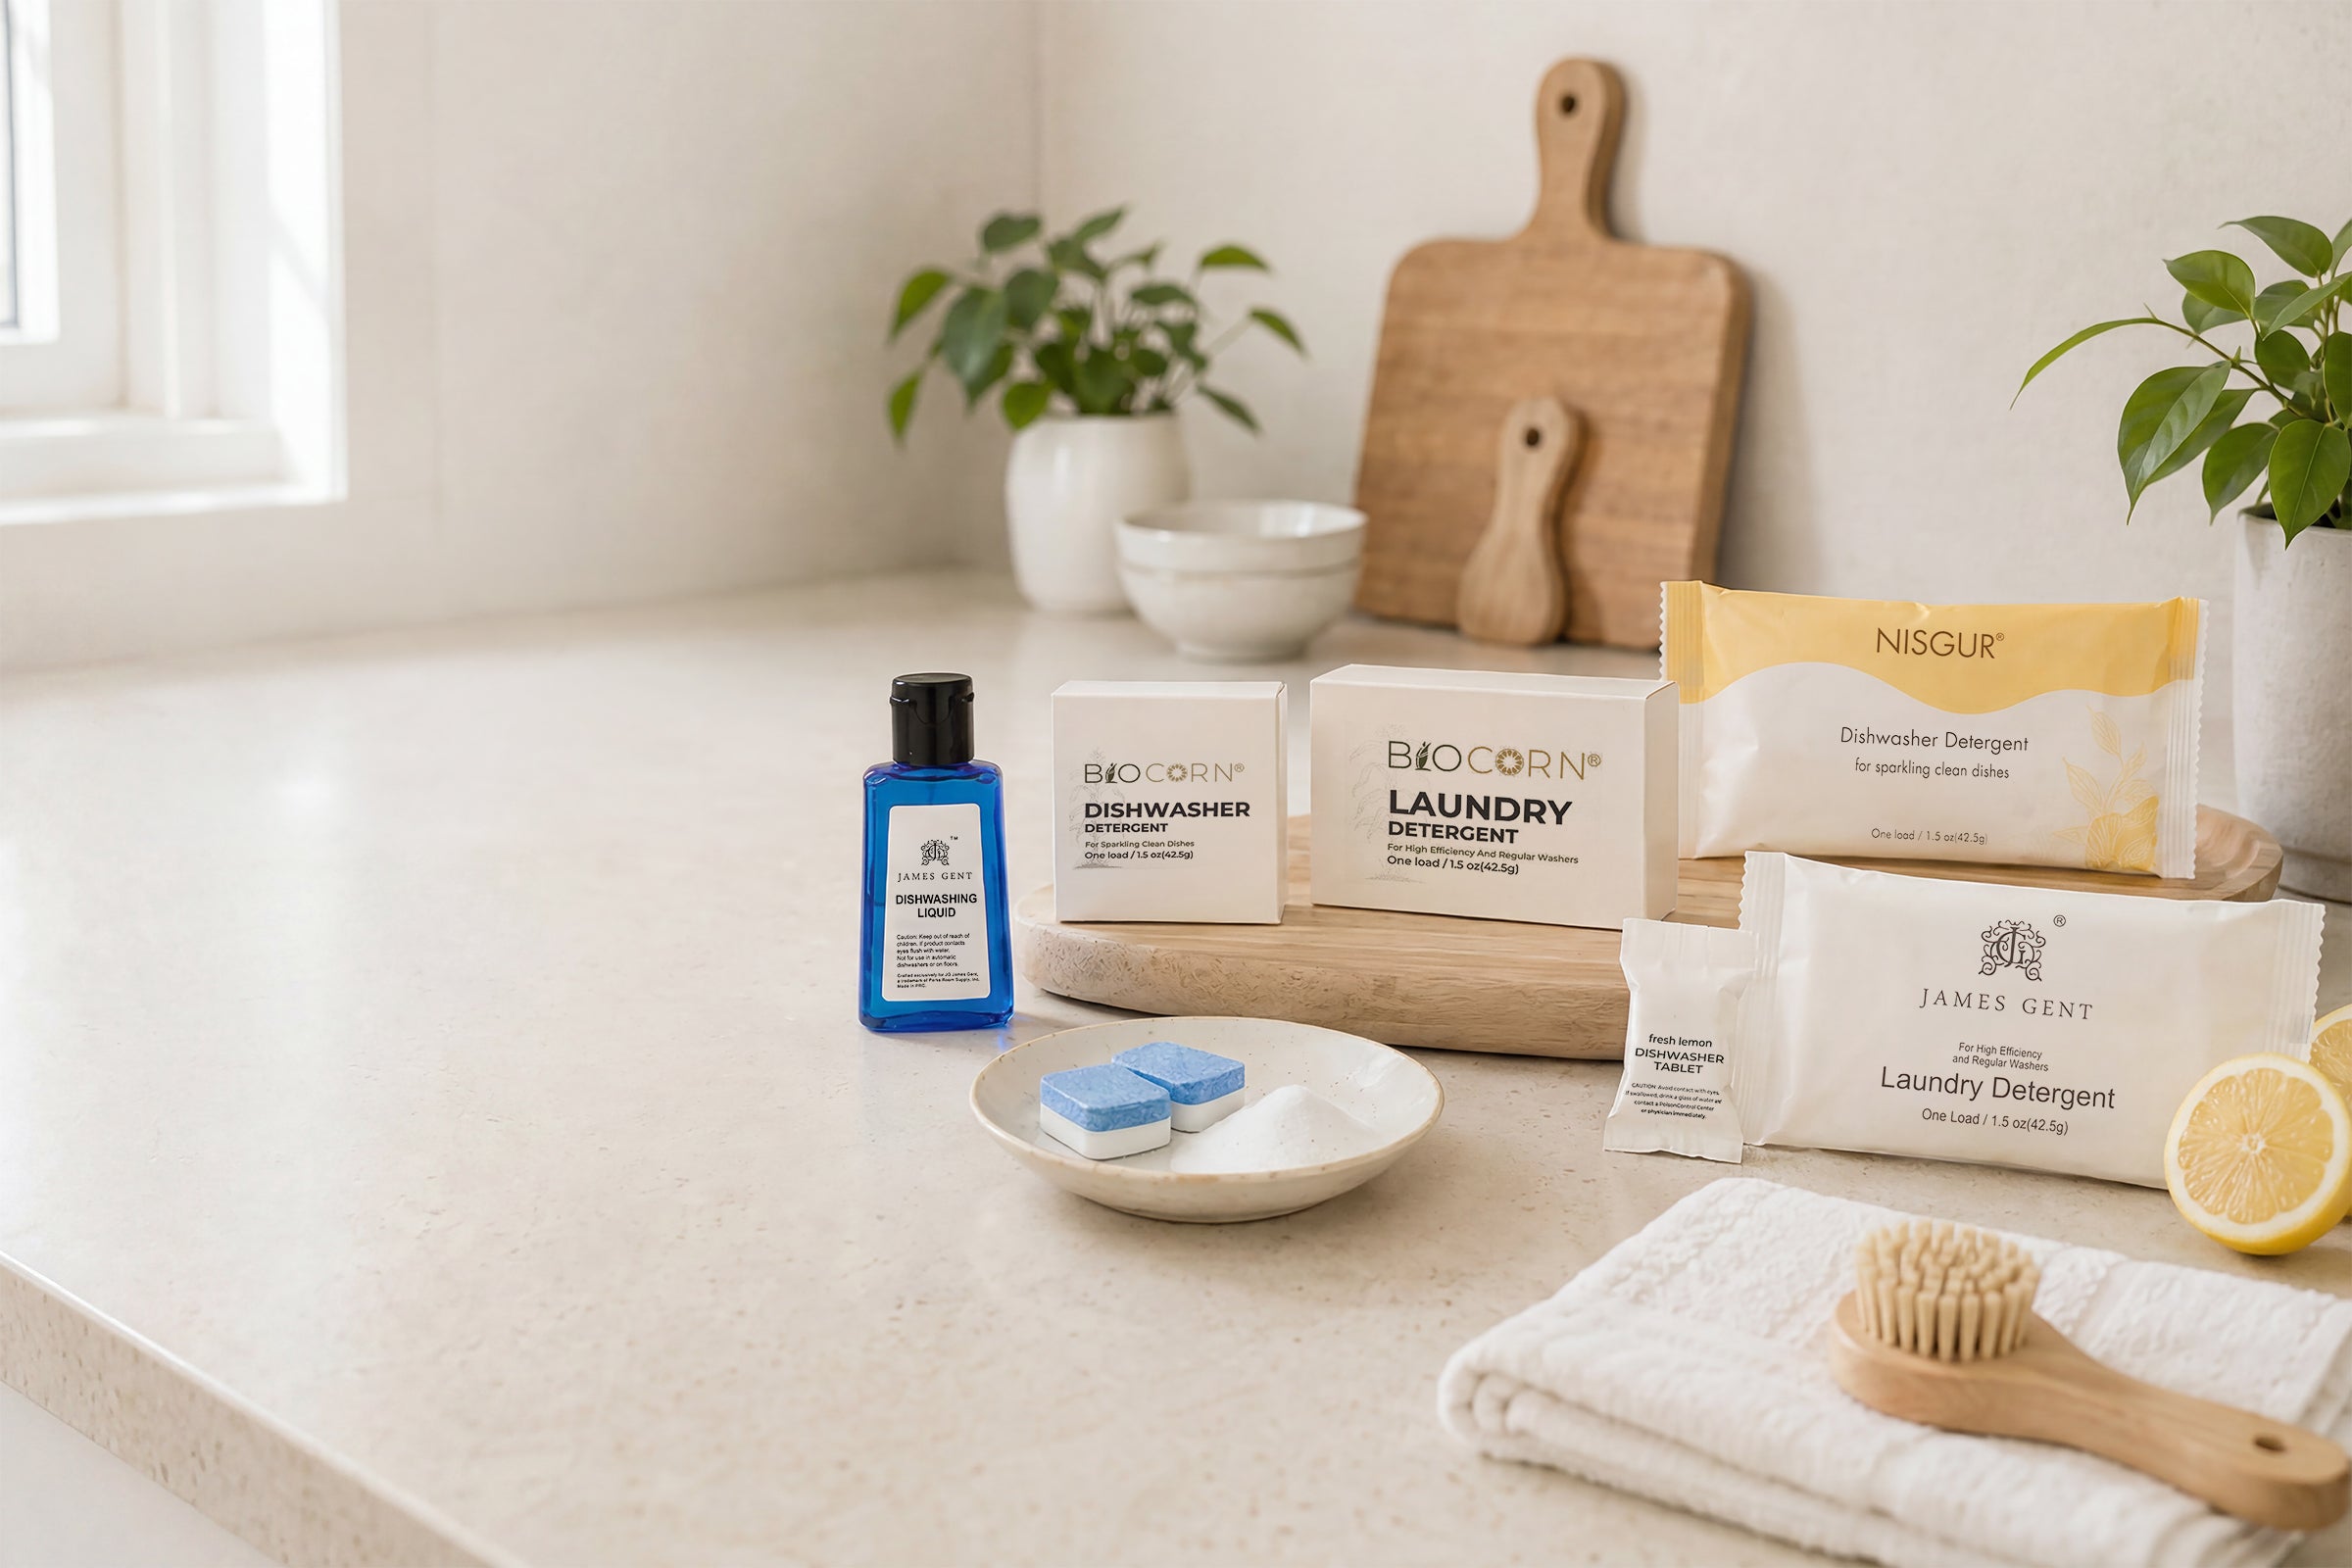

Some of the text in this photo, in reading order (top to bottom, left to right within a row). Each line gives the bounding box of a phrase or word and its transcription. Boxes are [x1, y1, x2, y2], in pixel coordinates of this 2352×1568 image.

[1841, 727, 2028, 755] Dishwasher Detergent
[1856, 757, 2009, 778] for sparkling clean dishes
[1085, 802, 1250, 818] DISHWASHER
[1390, 789, 1572, 825] LAUNDRY
[1085, 823, 1168, 832] DETERGENT
[1388, 821, 1518, 843] DETERGENT
[1872, 828, 1988, 845] One load / 1.5 oz(42.5g)
[1130, 851, 1135, 859] /
[1150, 851, 1193, 859] oz(42.5g)
[1406, 844, 1427, 854] High
[1430, 846, 1475, 857] Efficiency
[1477, 849, 1496, 858] And
[1499, 851, 1535, 861] Regular
[1538, 854, 1578, 864] Washers
[1387, 855, 1519, 875] One load / 1.5 oz(42.5g)
[898, 873, 934, 882] JAMES
[896, 894, 977, 904] DISHWASHING
[918, 908, 955, 917] LIQUID
[1919, 988, 2092, 1019] JAMES GENT
[1649, 1034, 1712, 1047] fresh lemon
[1635, 1048, 1724, 1064] DISHWASHER
[1959, 1043, 2043, 1061] For High Efficiency
[1654, 1061, 1703, 1073] TABLET
[1953, 1054, 2048, 1072] and Regular Washers
[1881, 1066, 2115, 1110] Laundry Detergent
[1922, 1108, 2068, 1135] One Load / 1.5 oz(42.5g)
